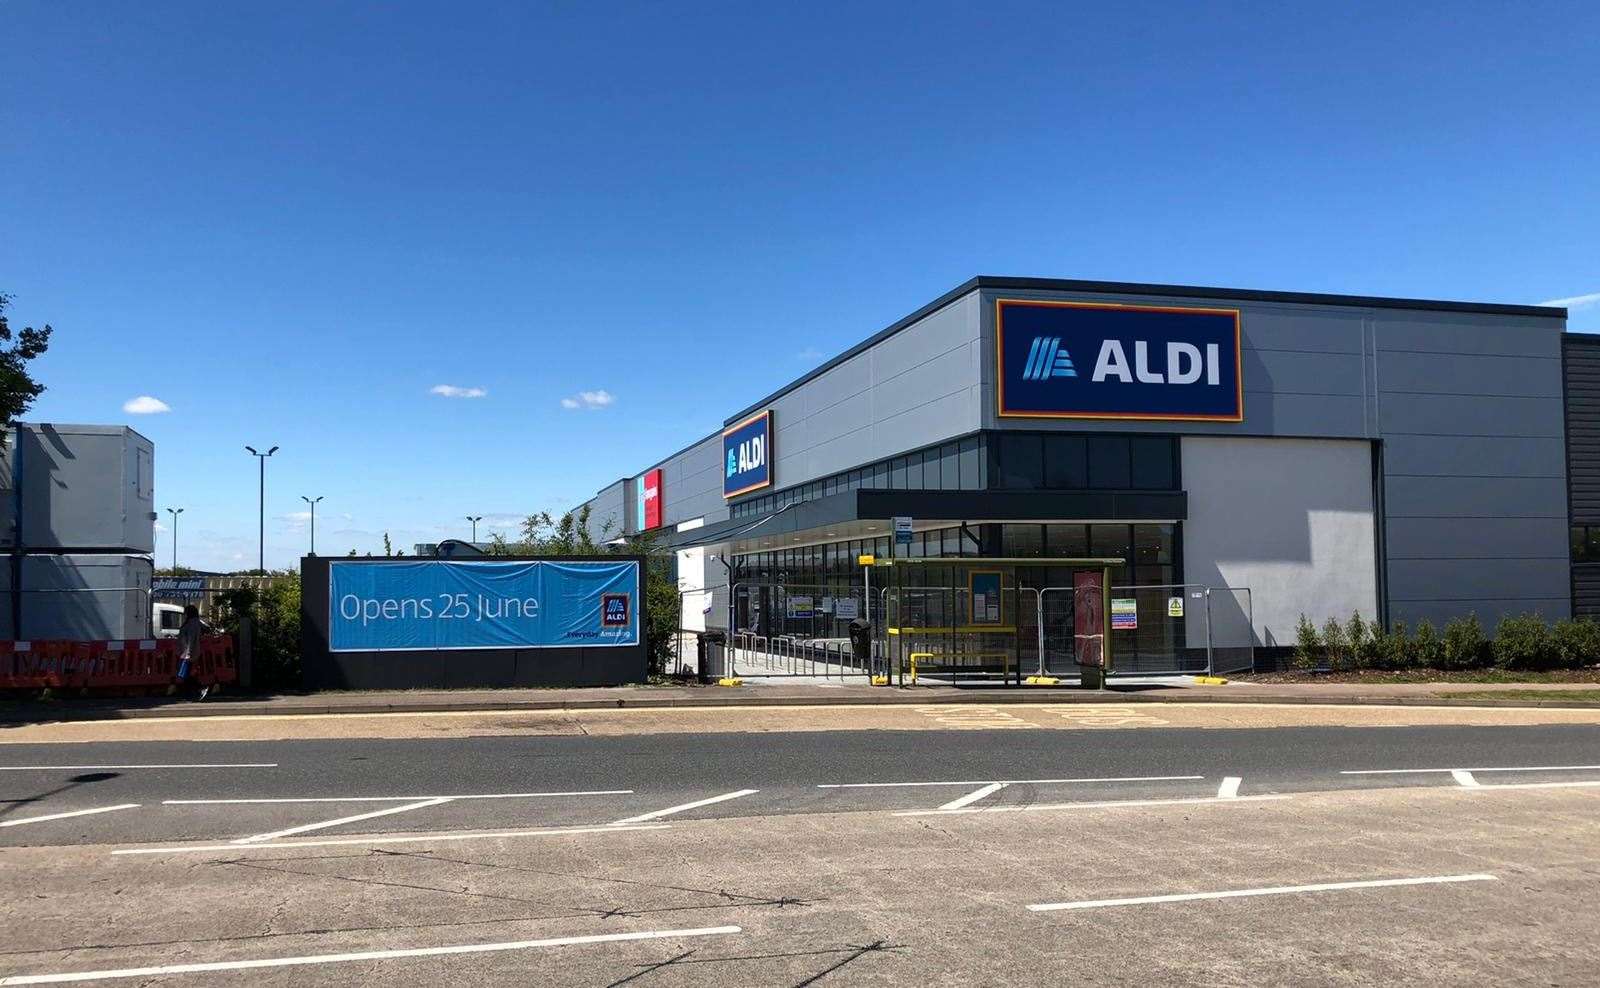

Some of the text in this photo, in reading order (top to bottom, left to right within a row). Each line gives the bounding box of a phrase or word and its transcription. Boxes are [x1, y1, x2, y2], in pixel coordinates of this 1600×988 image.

[1092, 339, 1220, 386] ALDI
[738, 434, 765, 474] ALDI
[178, 579, 201, 589] mini
[340, 593, 539, 626] Opens 25 June
[606, 613, 626, 621] ALDI
